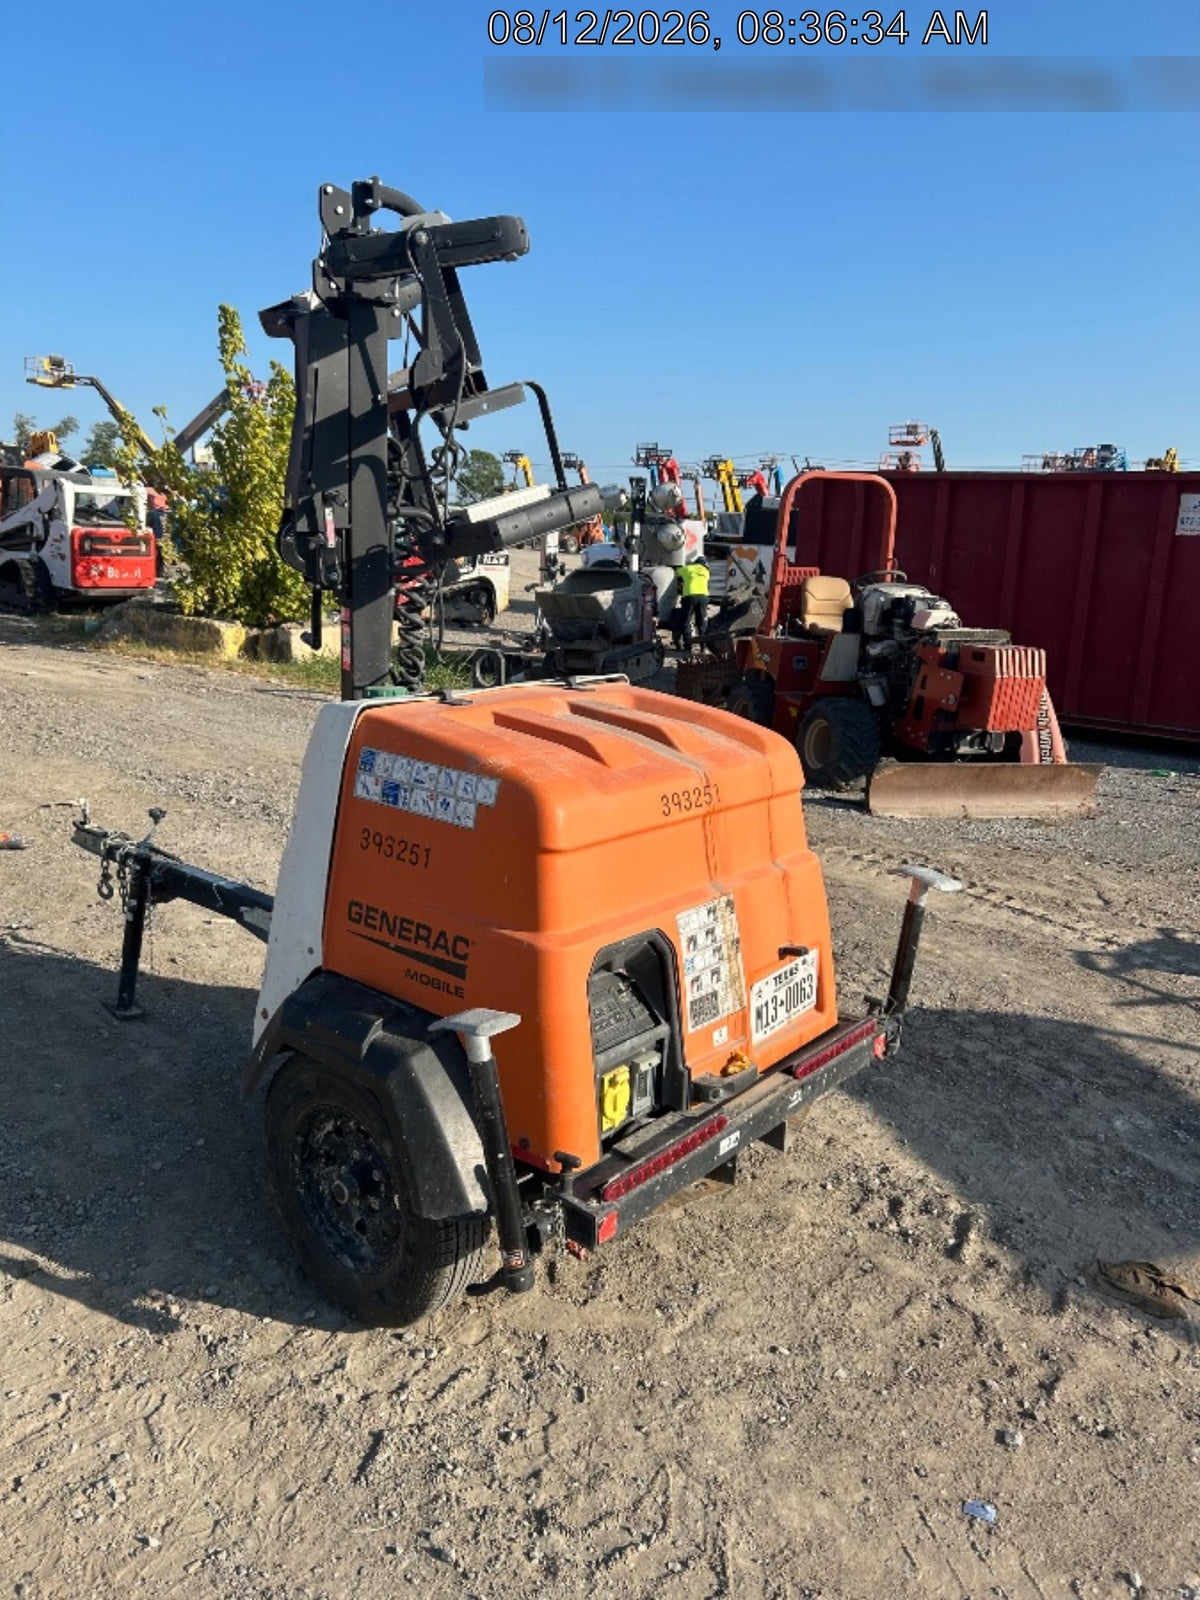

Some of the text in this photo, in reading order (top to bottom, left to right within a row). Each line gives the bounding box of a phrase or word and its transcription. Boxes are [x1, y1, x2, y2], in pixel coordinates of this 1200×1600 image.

[660, 783, 721, 817] 393251
[360, 828, 431, 869] 393251
[347, 900, 470, 961] GENERAC
[405, 968, 465, 1000] MOBILE
